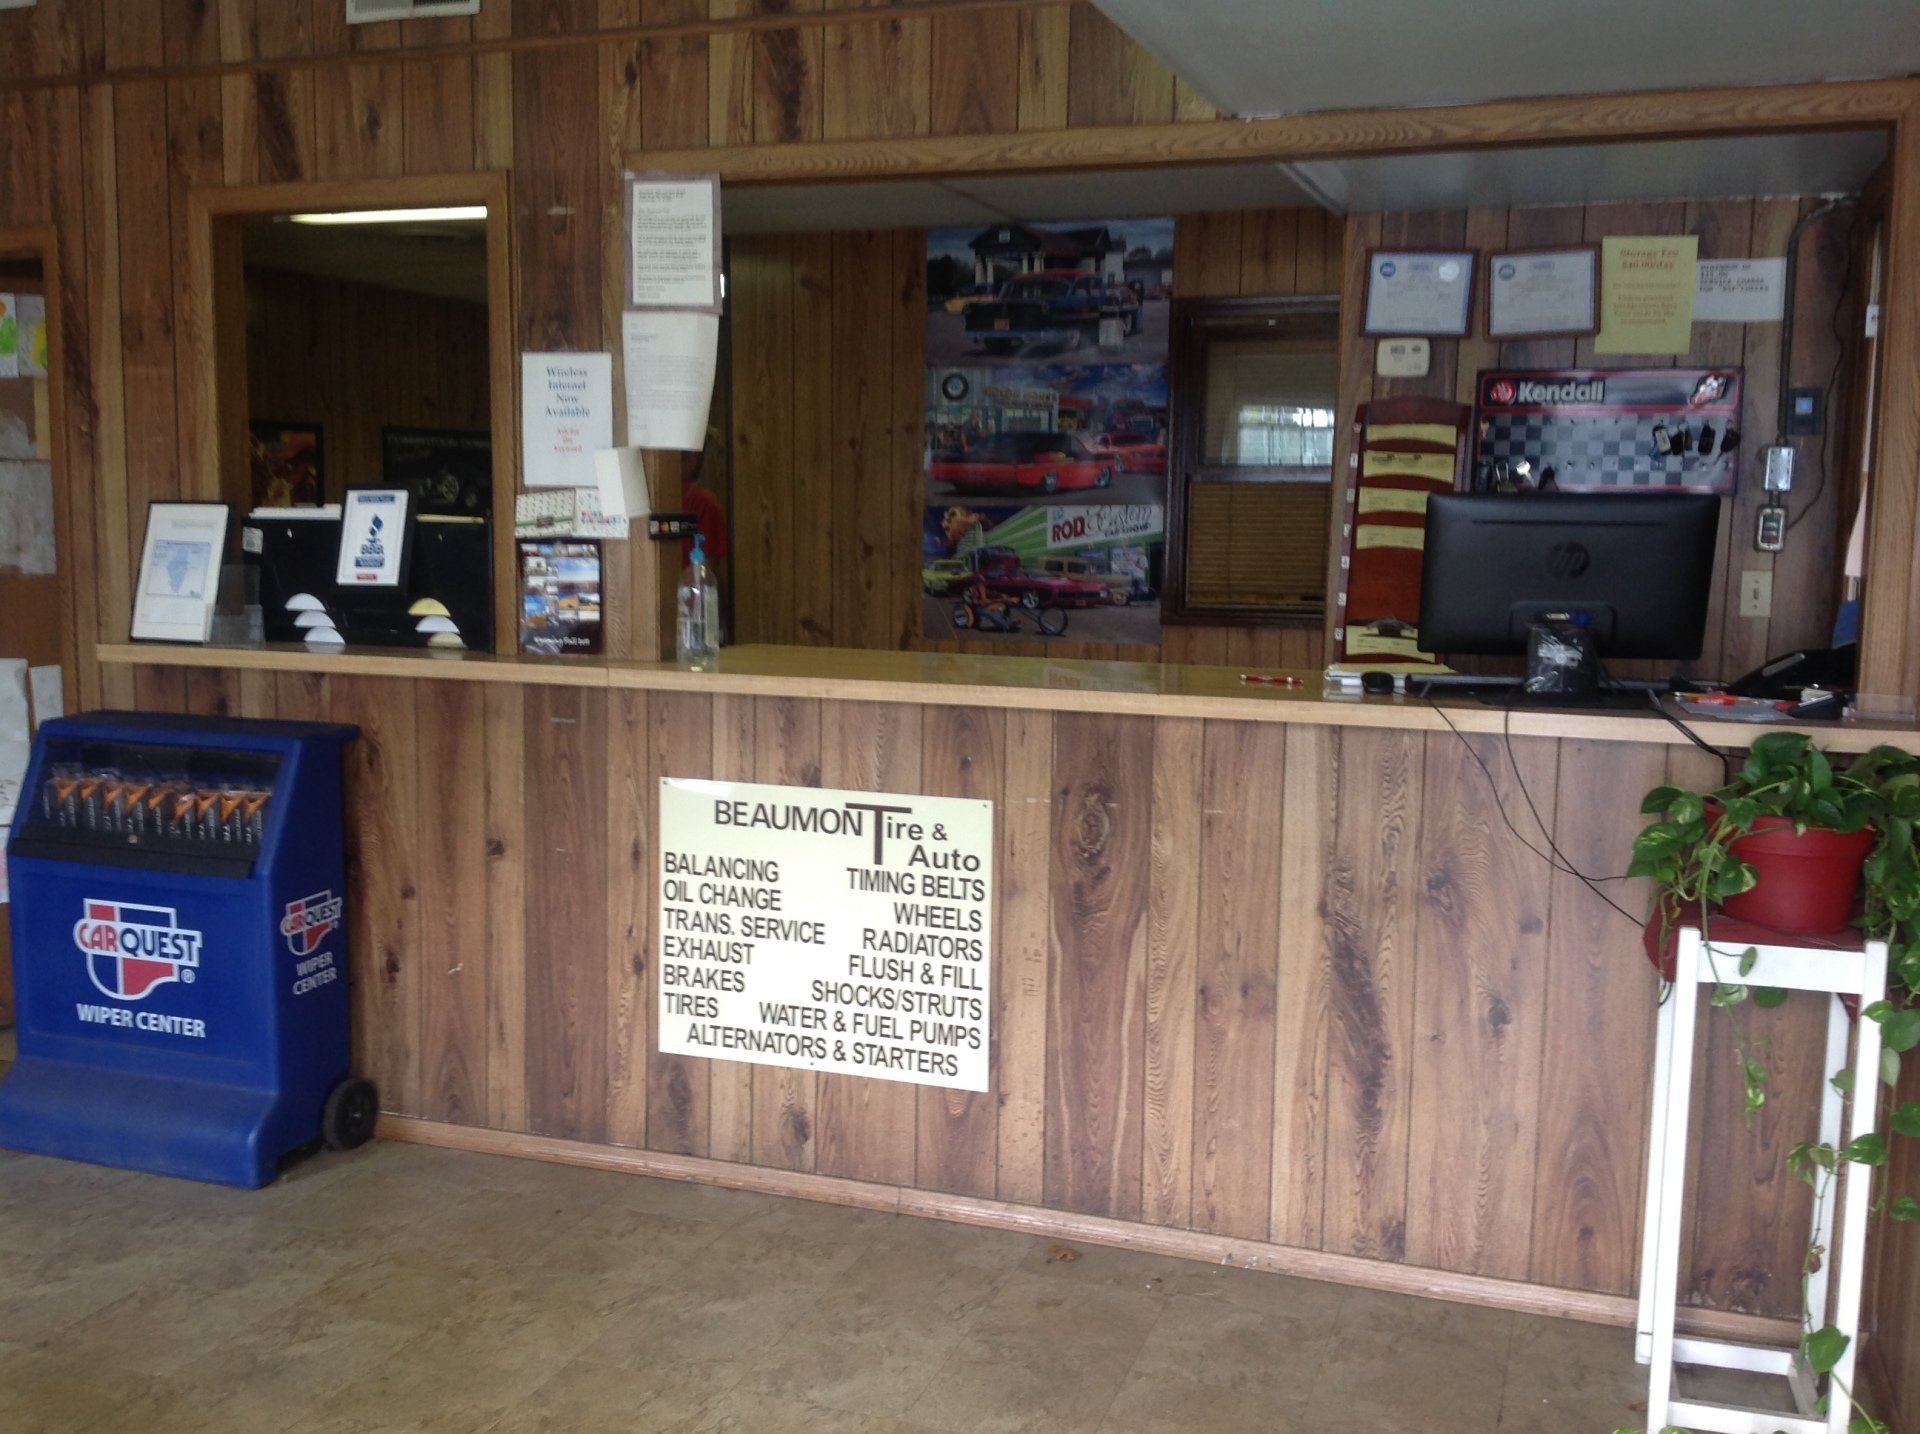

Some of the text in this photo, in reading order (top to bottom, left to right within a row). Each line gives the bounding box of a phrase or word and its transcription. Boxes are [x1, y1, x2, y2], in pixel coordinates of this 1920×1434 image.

[1518, 380, 1604, 402] Kendall
[1052, 515, 1085, 542] ROD
[932, 823, 948, 841] &
[664, 851, 780, 883] BALANCING
[908, 844, 981, 872] Auto
[663, 879, 782, 911] OIL CHANGE
[846, 867, 986, 902] TIMING BELTS
[663, 907, 826, 945] TRANS. SERVICE
[893, 901, 982, 932] WHEELS
[79, 922, 197, 962] CARQUEST
[663, 935, 755, 965] EXHAUST
[863, 927, 983, 962] RADIATORS
[293, 967, 337, 995] CENTER
[663, 963, 746, 993] BRAKES
[849, 954, 983, 991] FLUSH & FILL
[663, 992, 719, 1019] TIRES
[811, 979, 983, 1021] SHOCKS/STRUTS
[76, 1003, 206, 1038] WIPER CENTER
[759, 1001, 982, 1050] WATER & FUEL PUMPS
[686, 1022, 959, 1077] ALTERNATORS & STARTERS
